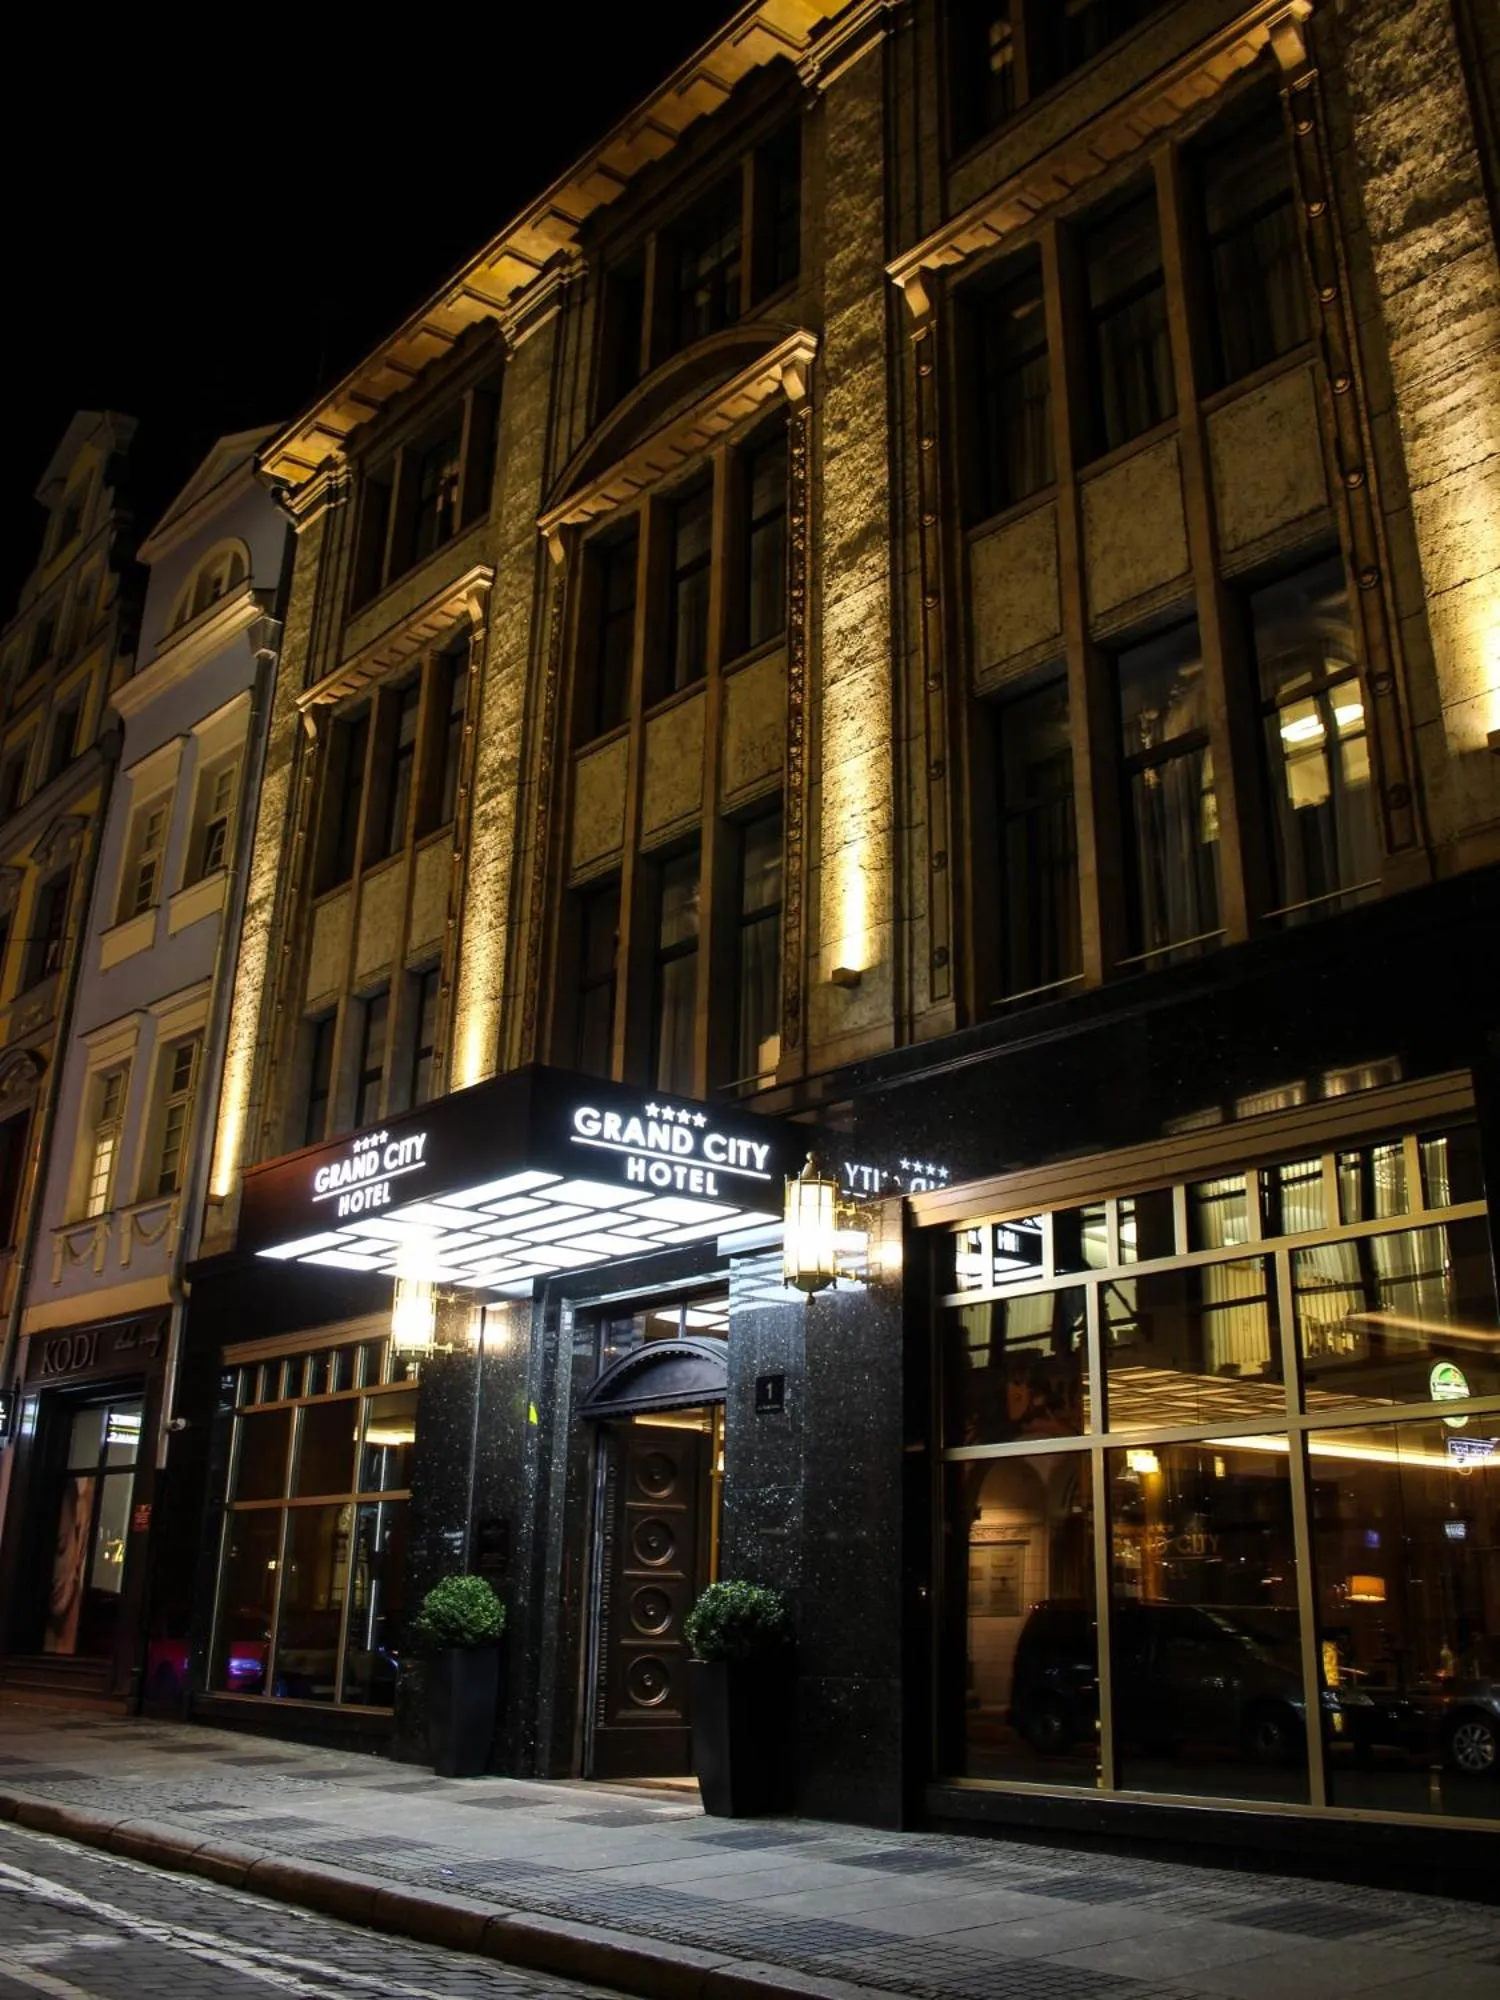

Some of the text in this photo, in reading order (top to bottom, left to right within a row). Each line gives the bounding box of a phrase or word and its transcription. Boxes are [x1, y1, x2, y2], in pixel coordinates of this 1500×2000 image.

[573, 1106, 770, 1170] GRAND CITY
[314, 1132, 427, 1193] GRAND CITY
[626, 1156, 719, 1196] HOTEL
[338, 1181, 391, 1217] HOTEL
[41, 1331, 98, 1374] KODI
[765, 1381, 773, 1400] 1
